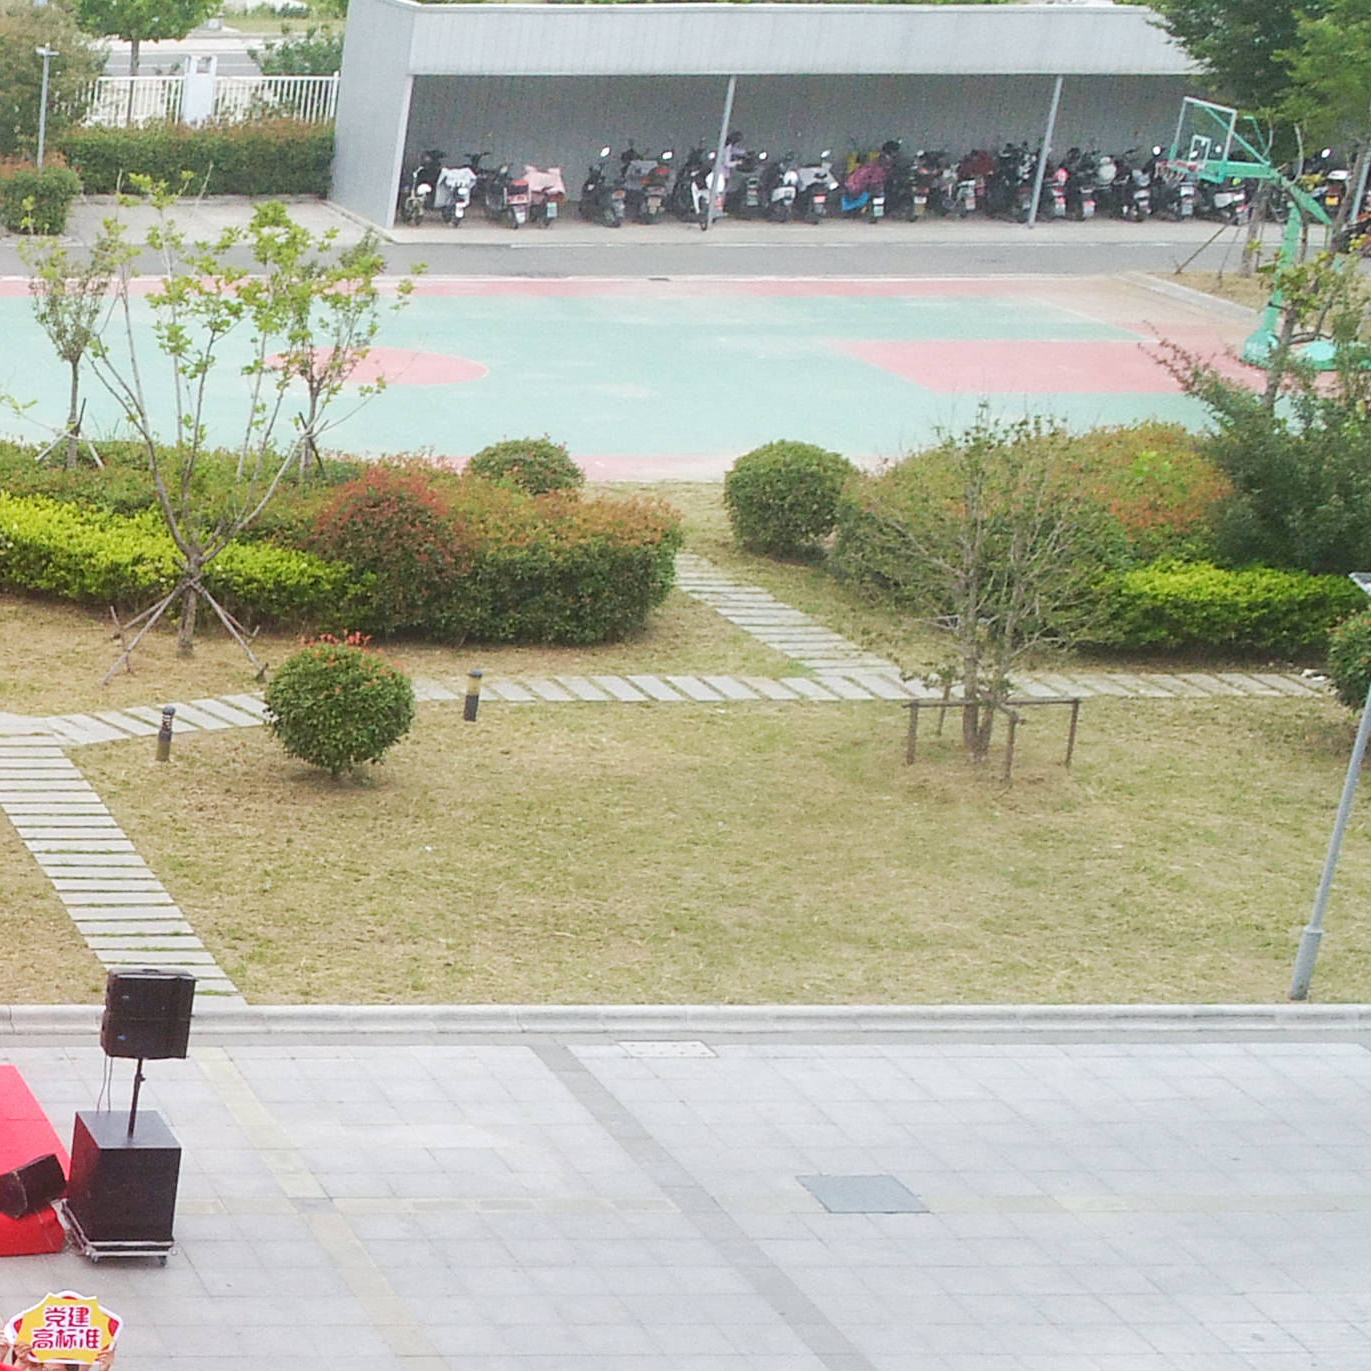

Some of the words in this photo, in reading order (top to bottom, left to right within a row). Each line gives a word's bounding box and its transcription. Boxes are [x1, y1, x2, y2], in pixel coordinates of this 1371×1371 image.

[44, 1306, 90, 1328] 党建
[32, 1328, 100, 1349] 高标准
